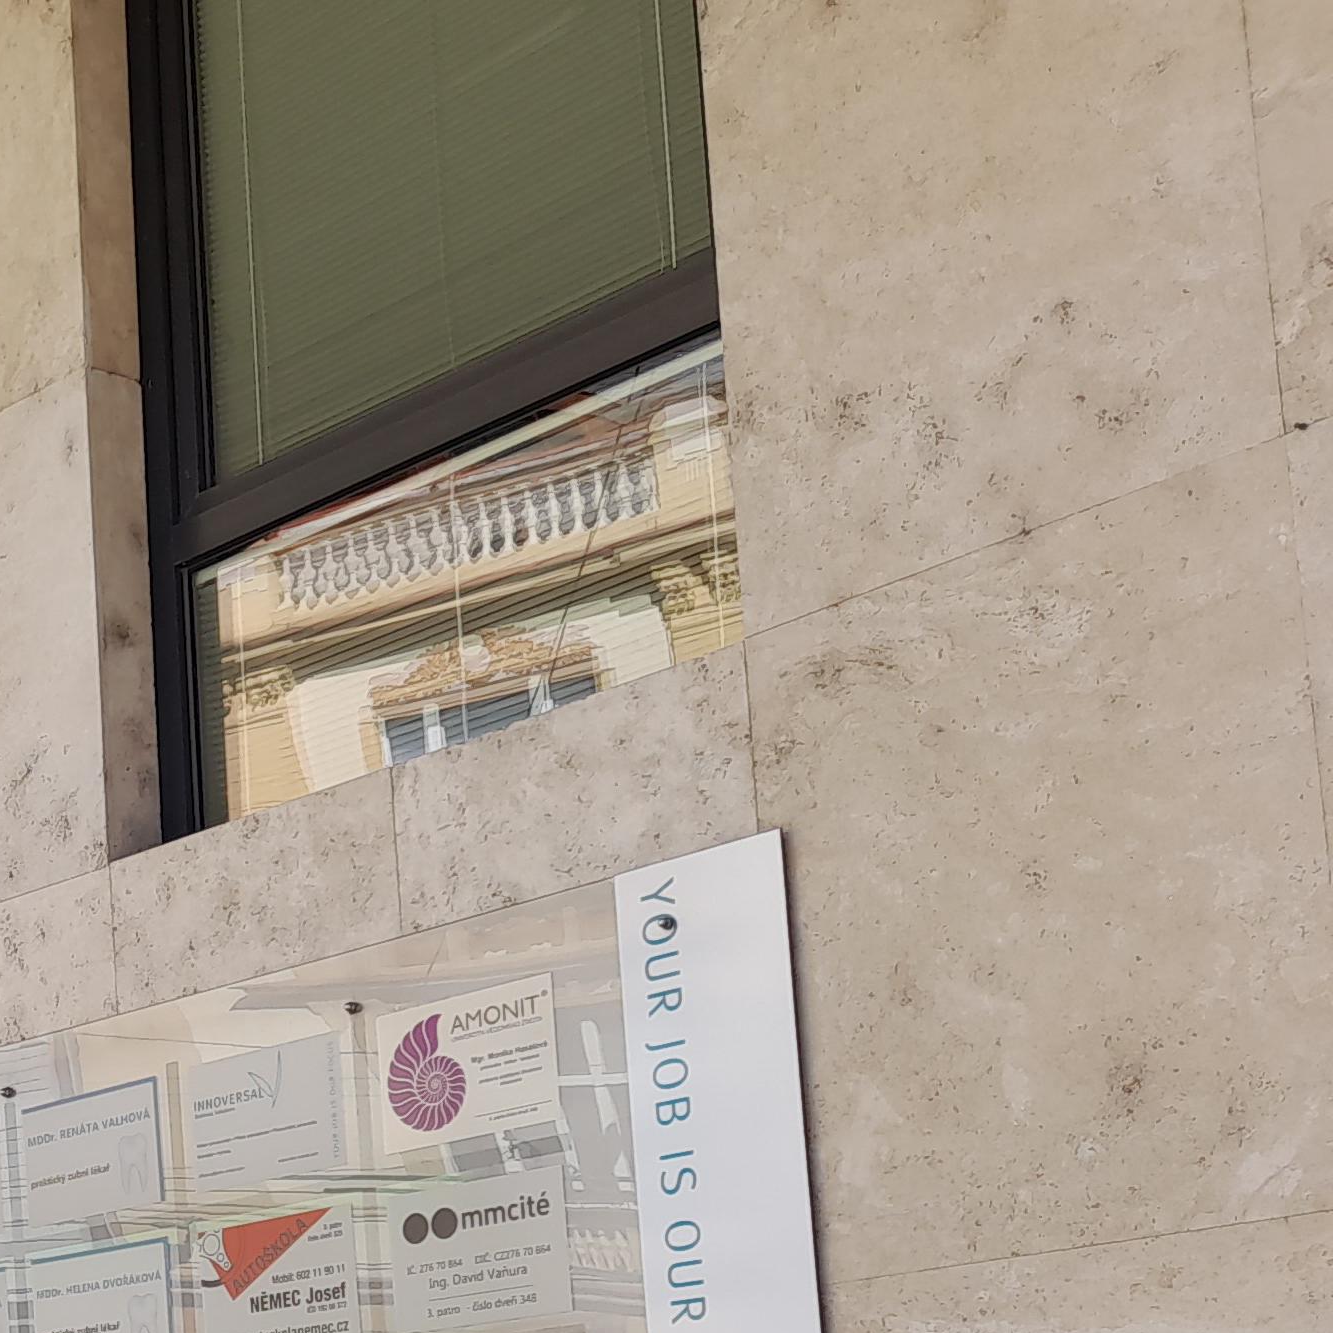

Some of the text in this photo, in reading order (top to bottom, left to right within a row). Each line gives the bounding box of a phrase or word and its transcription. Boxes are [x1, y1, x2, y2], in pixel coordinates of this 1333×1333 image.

[640, 876, 684, 1018] YOUR
[194, 1087, 265, 1112] INNOVERSAL
[645, 1038, 691, 1127] JOB
[659, 1149, 697, 1196] IS
[461, 1191, 550, 1230] mmcité
[429, 1277, 449, 1291] Ing.
[452, 1270, 484, 1286] David
[664, 1219, 710, 1325] OUR
[250, 1281, 347, 1313] NĚMEC Josef
